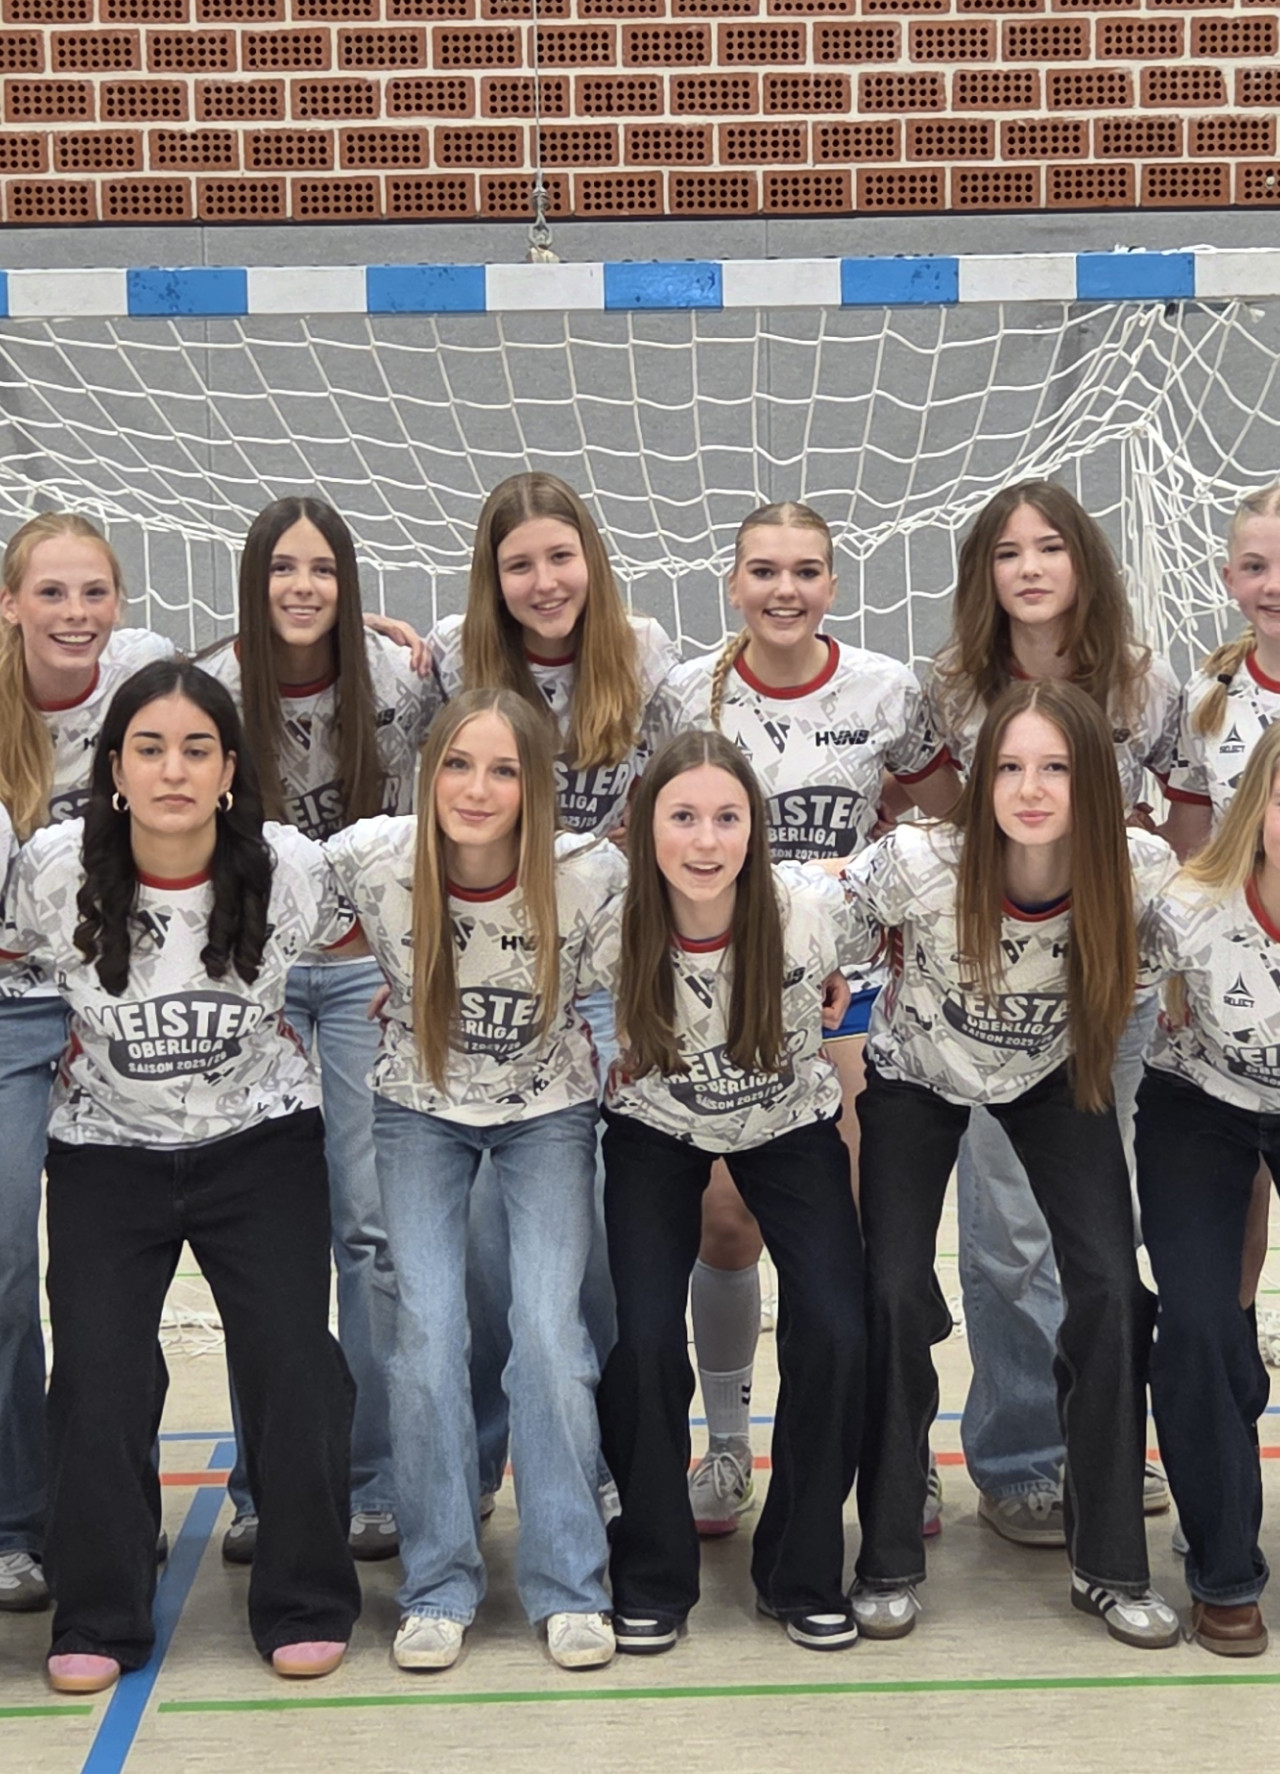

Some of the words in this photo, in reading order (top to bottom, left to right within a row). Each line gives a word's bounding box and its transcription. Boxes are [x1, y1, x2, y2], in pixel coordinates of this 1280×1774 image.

[769, 826, 837, 848] BERLIGA
[1223, 995, 1255, 1009] SELECT
[84, 1000, 263, 1042] MEISTER
[127, 1038, 224, 1060] OBERLIGA
[127, 1061, 174, 1074] SAISON
